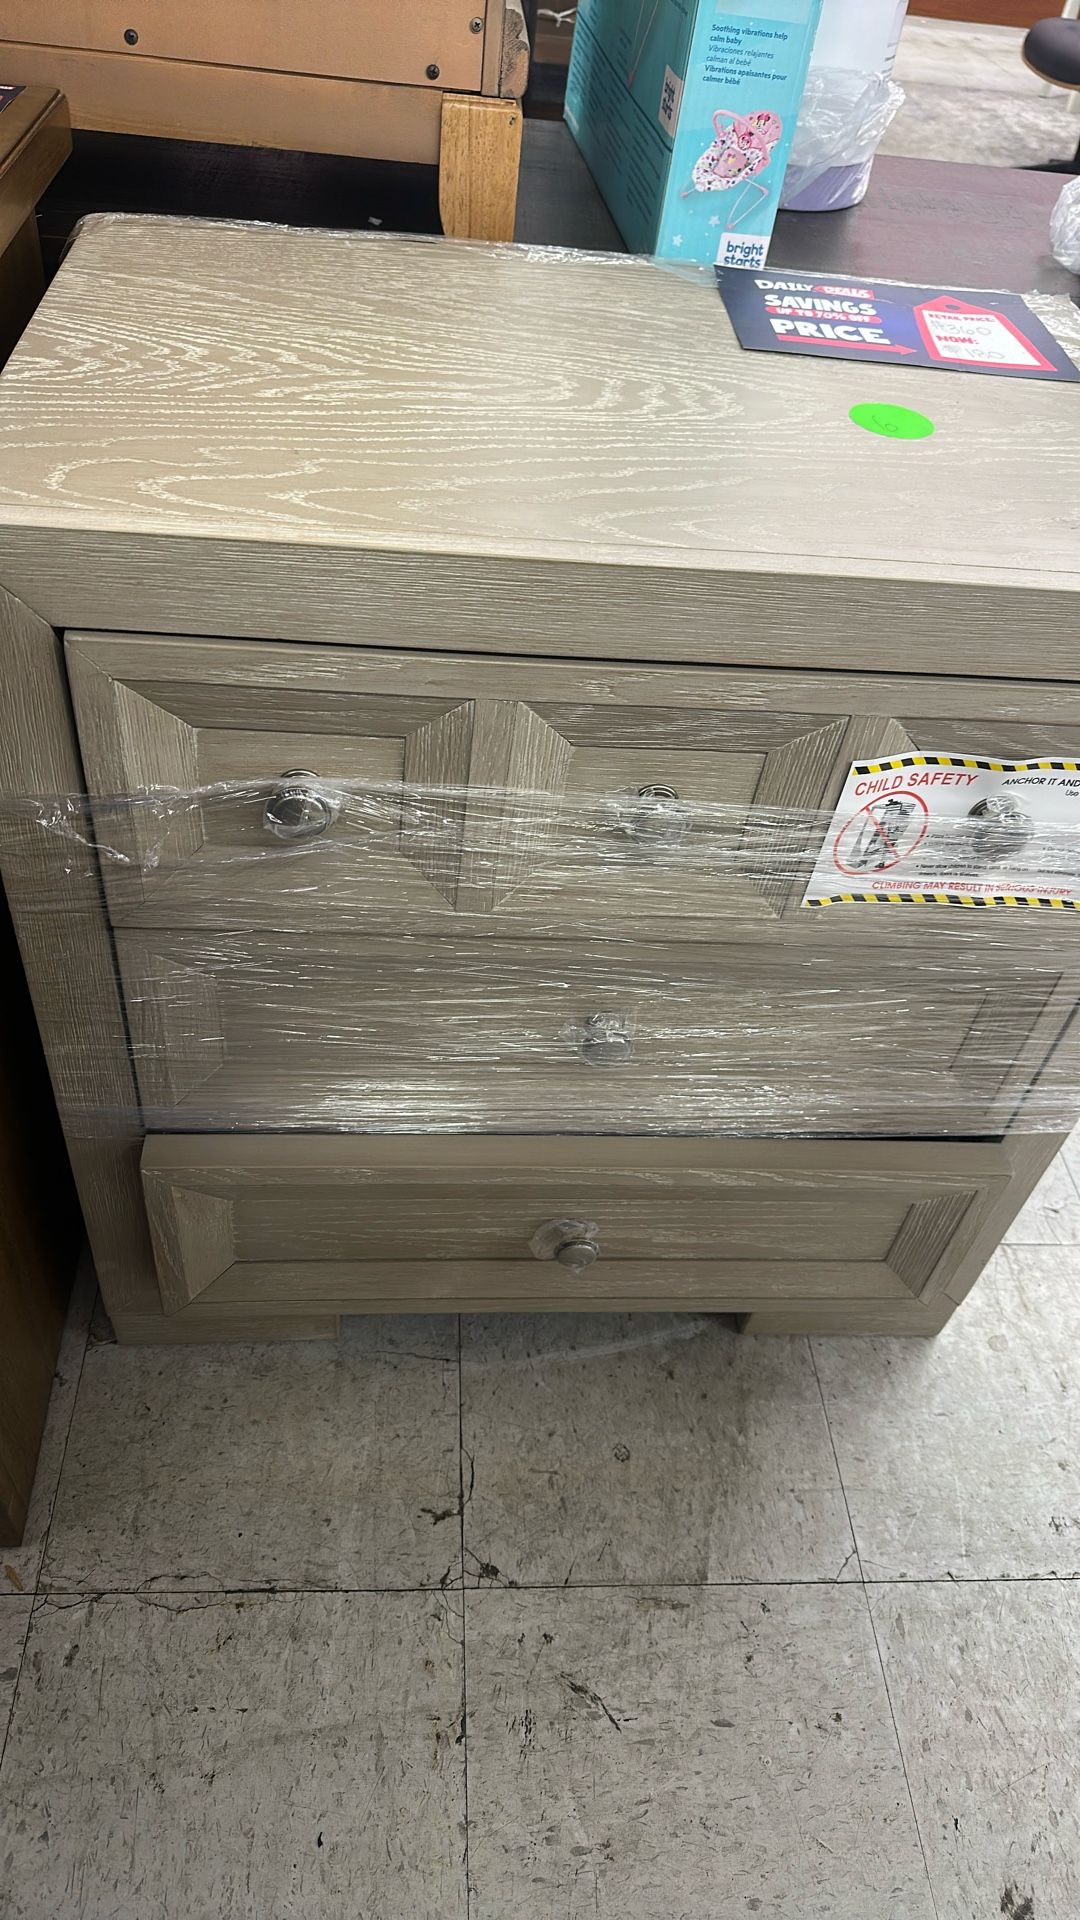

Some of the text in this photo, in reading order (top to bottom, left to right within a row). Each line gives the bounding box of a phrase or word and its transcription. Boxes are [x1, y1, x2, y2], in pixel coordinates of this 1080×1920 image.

[712, 24, 788, 41] Soothing vibrations help
[726, 36, 742, 46] baby
[708, 44, 774, 59] Vibraciones relajantes
[706, 55, 728, 63] calman
[728, 57, 736, 65] al
[702, 75, 724, 83] calmer
[705, 64, 788, 81] Vibrations apaisantes pour
[727, 240, 763, 258] bright
[724, 253, 761, 268] starts
[754, 279, 814, 292] DAILY
[764, 294, 877, 316] SAVINGS
[775, 307, 792, 316] UP
[815, 311, 847, 321] 70%
[848, 314, 871, 323] OFF
[928, 313, 961, 322] RETAIL
[769, 318, 891, 345] PRICE
[935, 335, 980, 345] NOW:
[855, 772, 980, 796] CHILD SAFETY
[1001, 777, 1080, 788] ANCHOR IT AND
[871, 881, 921, 890] CLIMBING
[923, 882, 945, 890] MAY
[948, 882, 983, 892] RESULT
[984, 884, 994, 892] IN
[1037, 886, 1073, 896] INJURY
